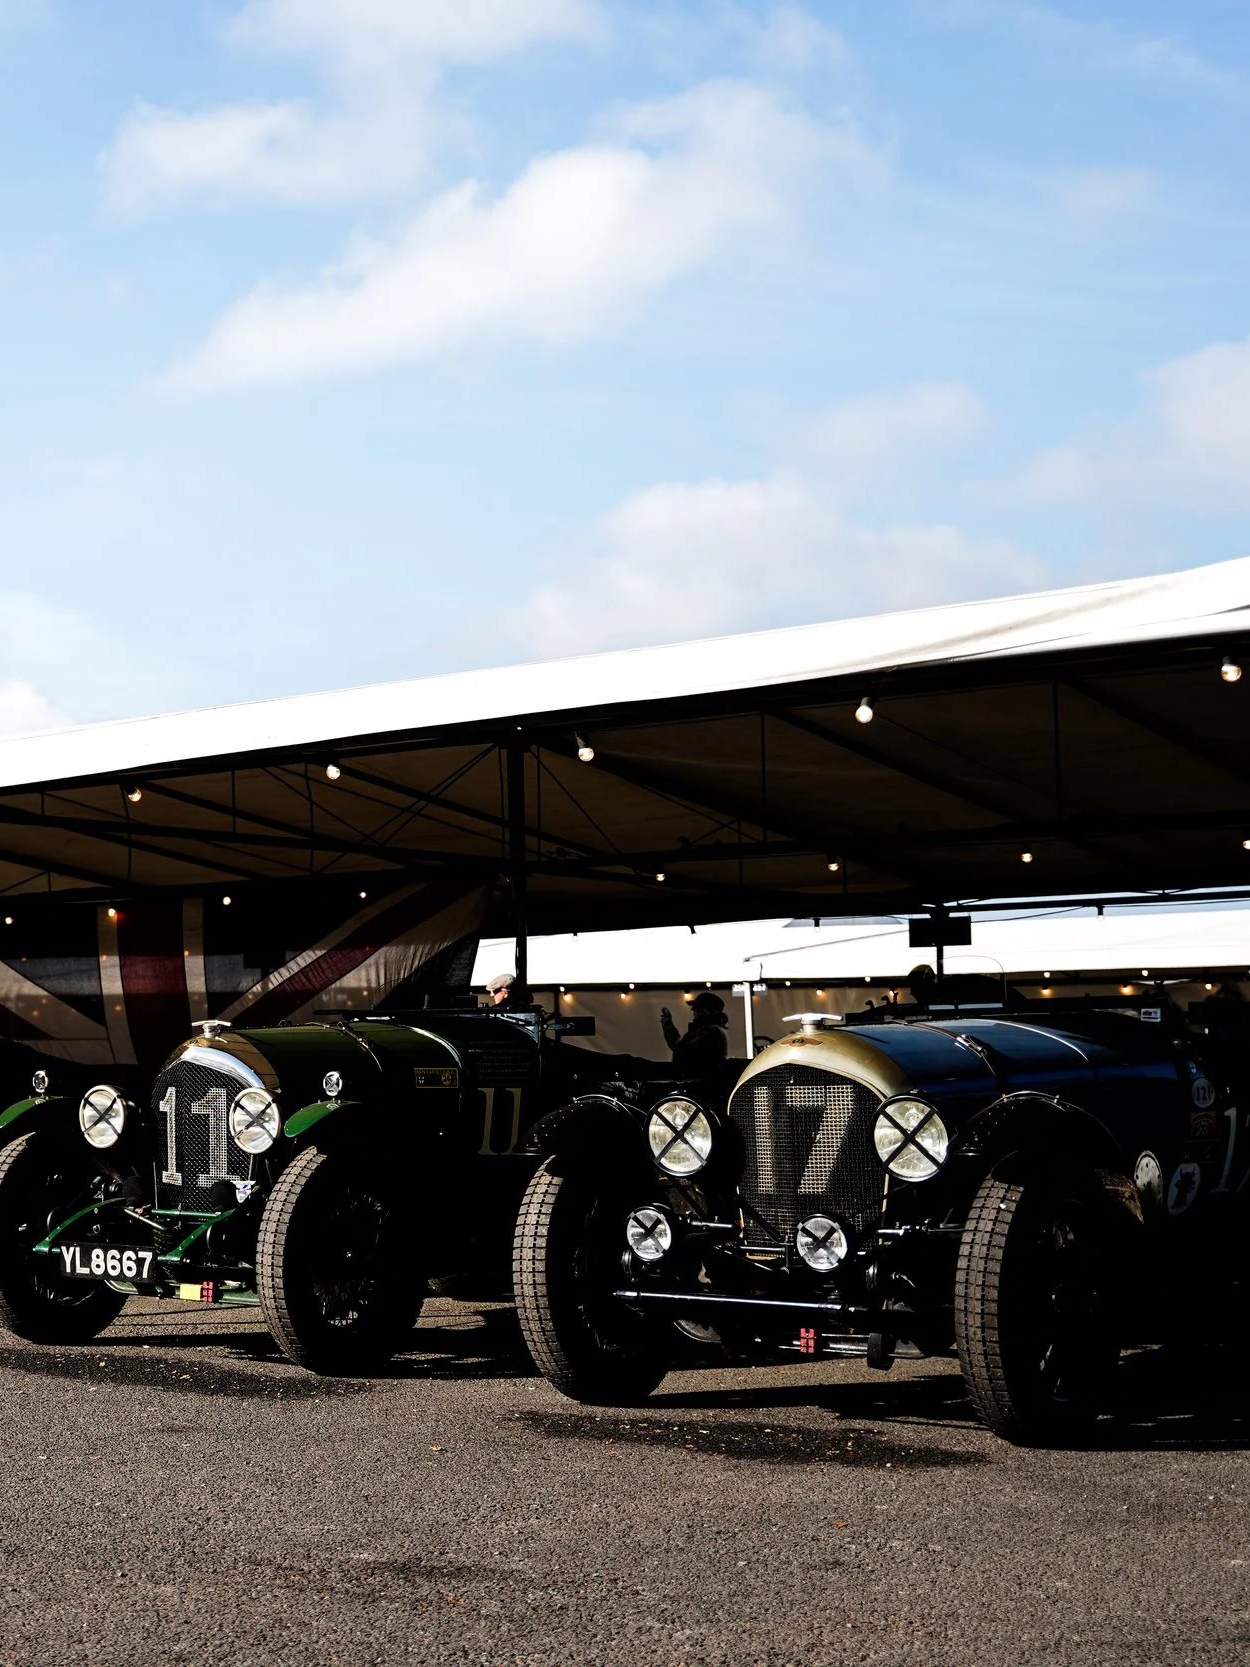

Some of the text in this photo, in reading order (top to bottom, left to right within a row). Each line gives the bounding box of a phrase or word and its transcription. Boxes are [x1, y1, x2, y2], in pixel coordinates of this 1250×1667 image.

[159, 1086, 241, 1189] 11
[477, 1087, 522, 1156] 11
[753, 1084, 854, 1195] 17
[1210, 1106, 1250, 1194] 1
[60, 1246, 153, 1279] YL8667
